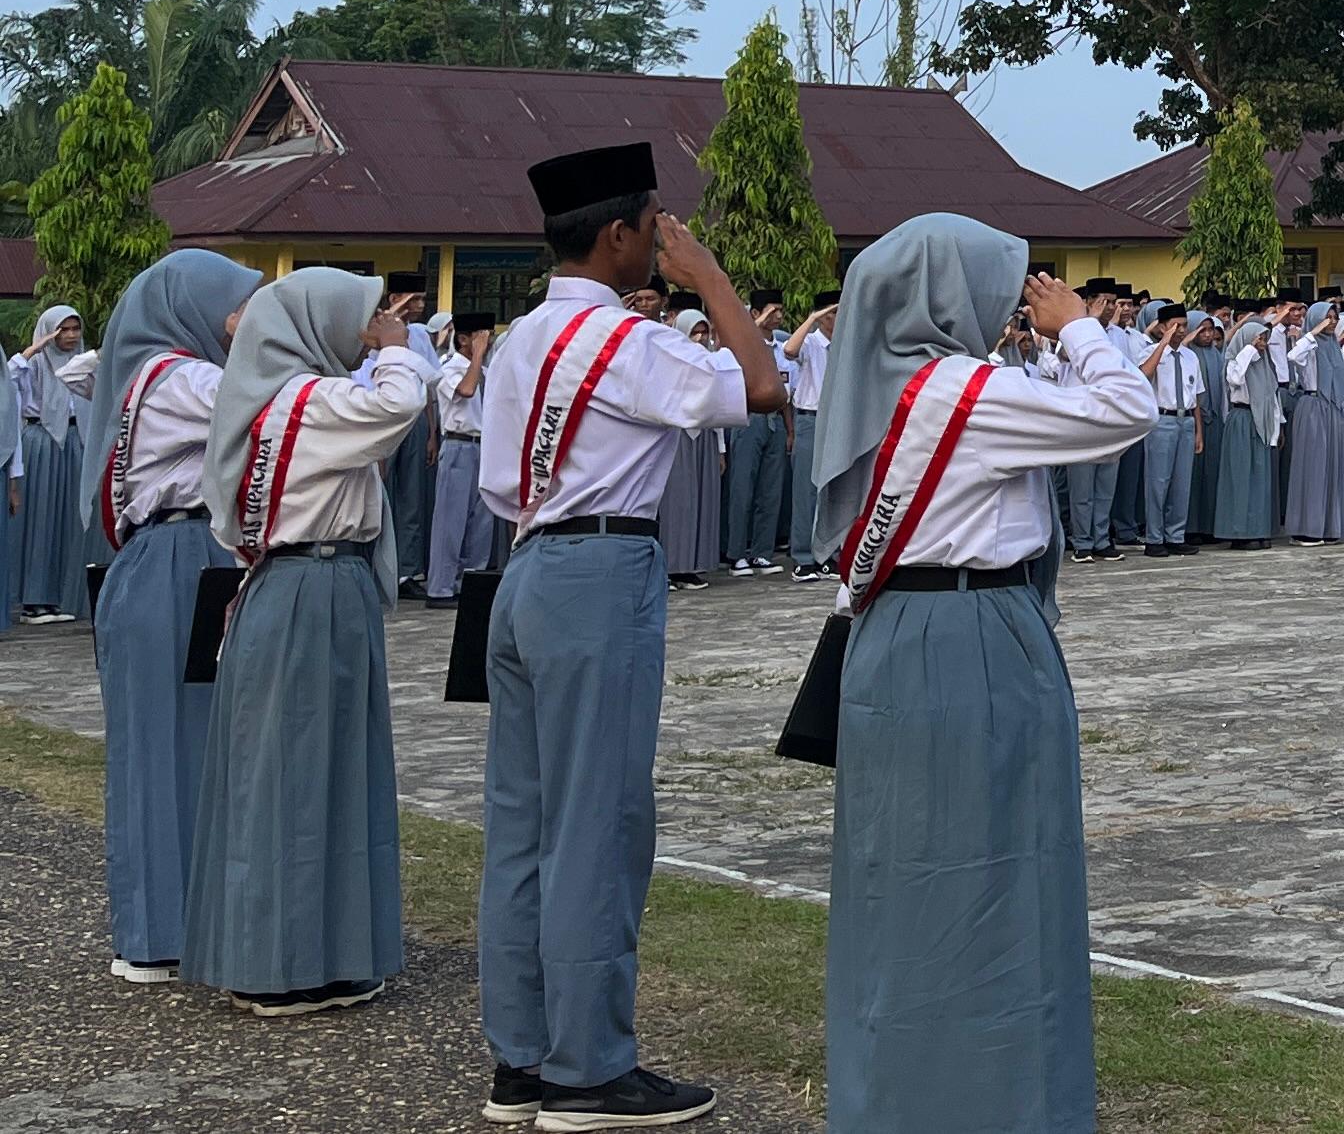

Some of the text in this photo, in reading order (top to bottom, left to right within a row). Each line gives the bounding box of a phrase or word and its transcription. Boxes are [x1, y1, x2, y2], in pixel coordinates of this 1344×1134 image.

[247, 437, 273, 515] UPACARA
[531, 405, 563, 479] UPACARA
[854, 492, 902, 574] UPACARA
